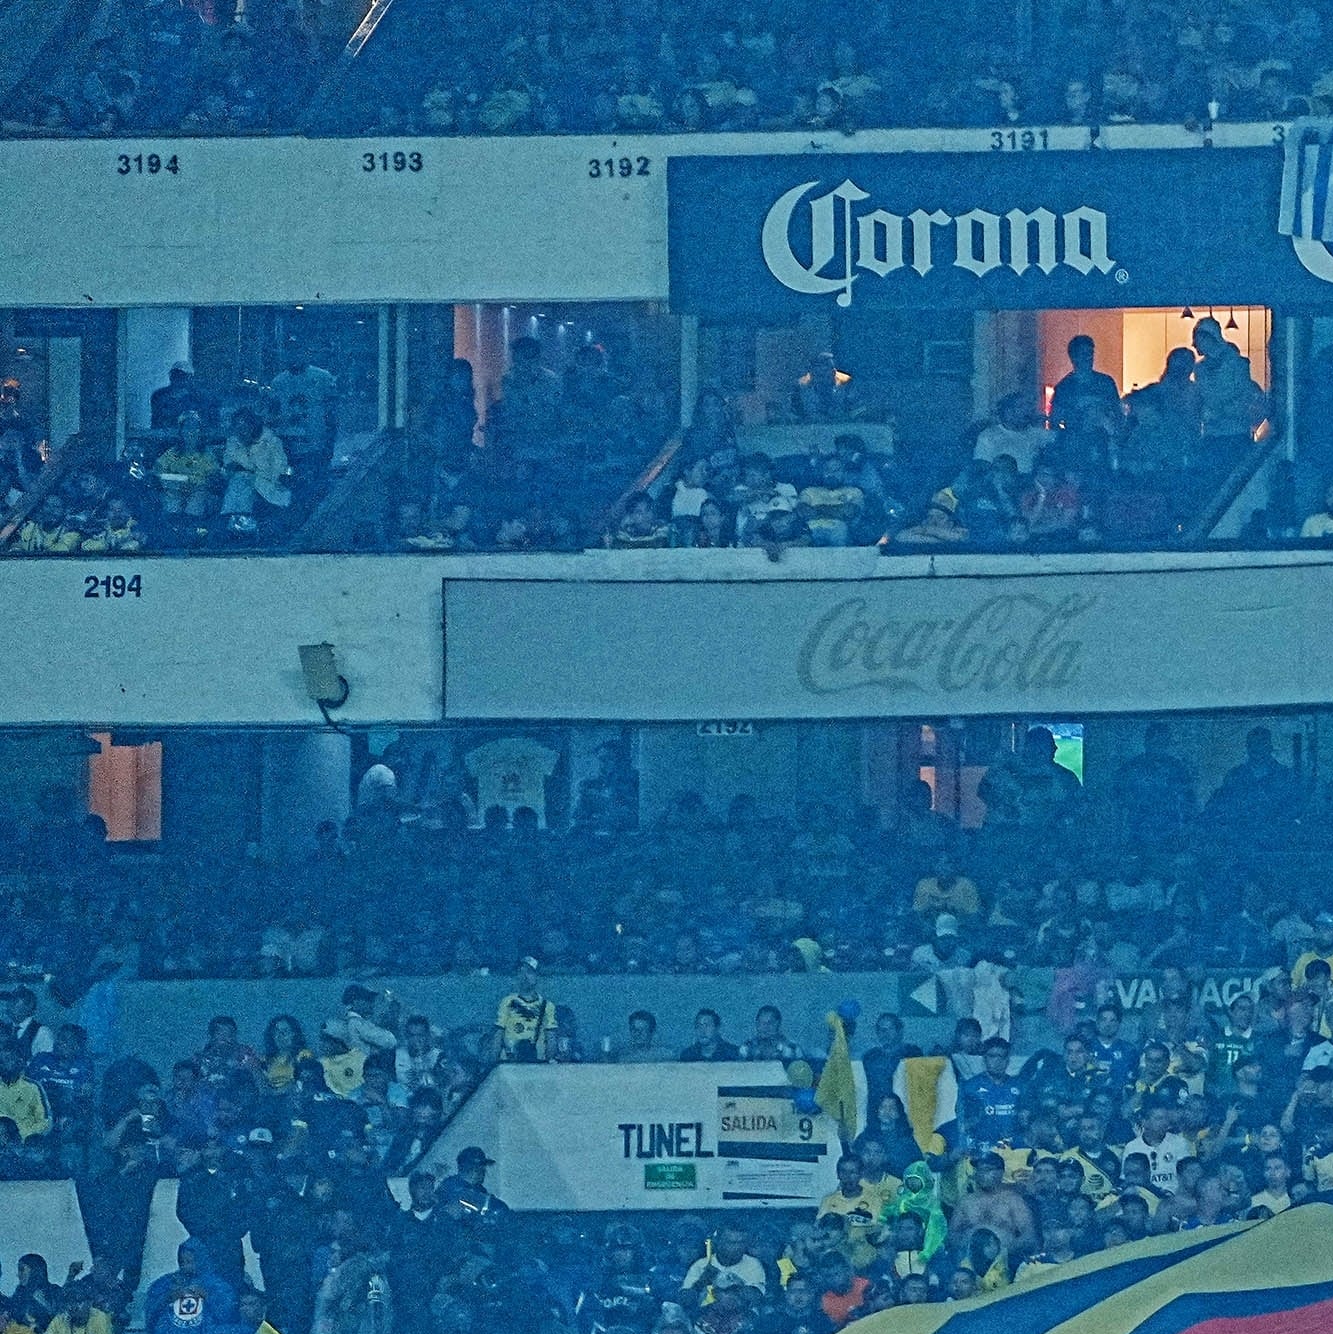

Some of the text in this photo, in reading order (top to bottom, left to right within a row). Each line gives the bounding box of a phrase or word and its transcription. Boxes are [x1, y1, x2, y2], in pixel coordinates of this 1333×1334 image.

[118, 154, 179, 175] 3194
[363, 152, 423, 172] 3193
[589, 156, 650, 178] 3192
[762, 178, 1117, 306] Corona
[85, 575, 141, 598] 2194
[618, 1122, 714, 1158] TUNEL
[721, 1116, 813, 1141] SALIDA 9
